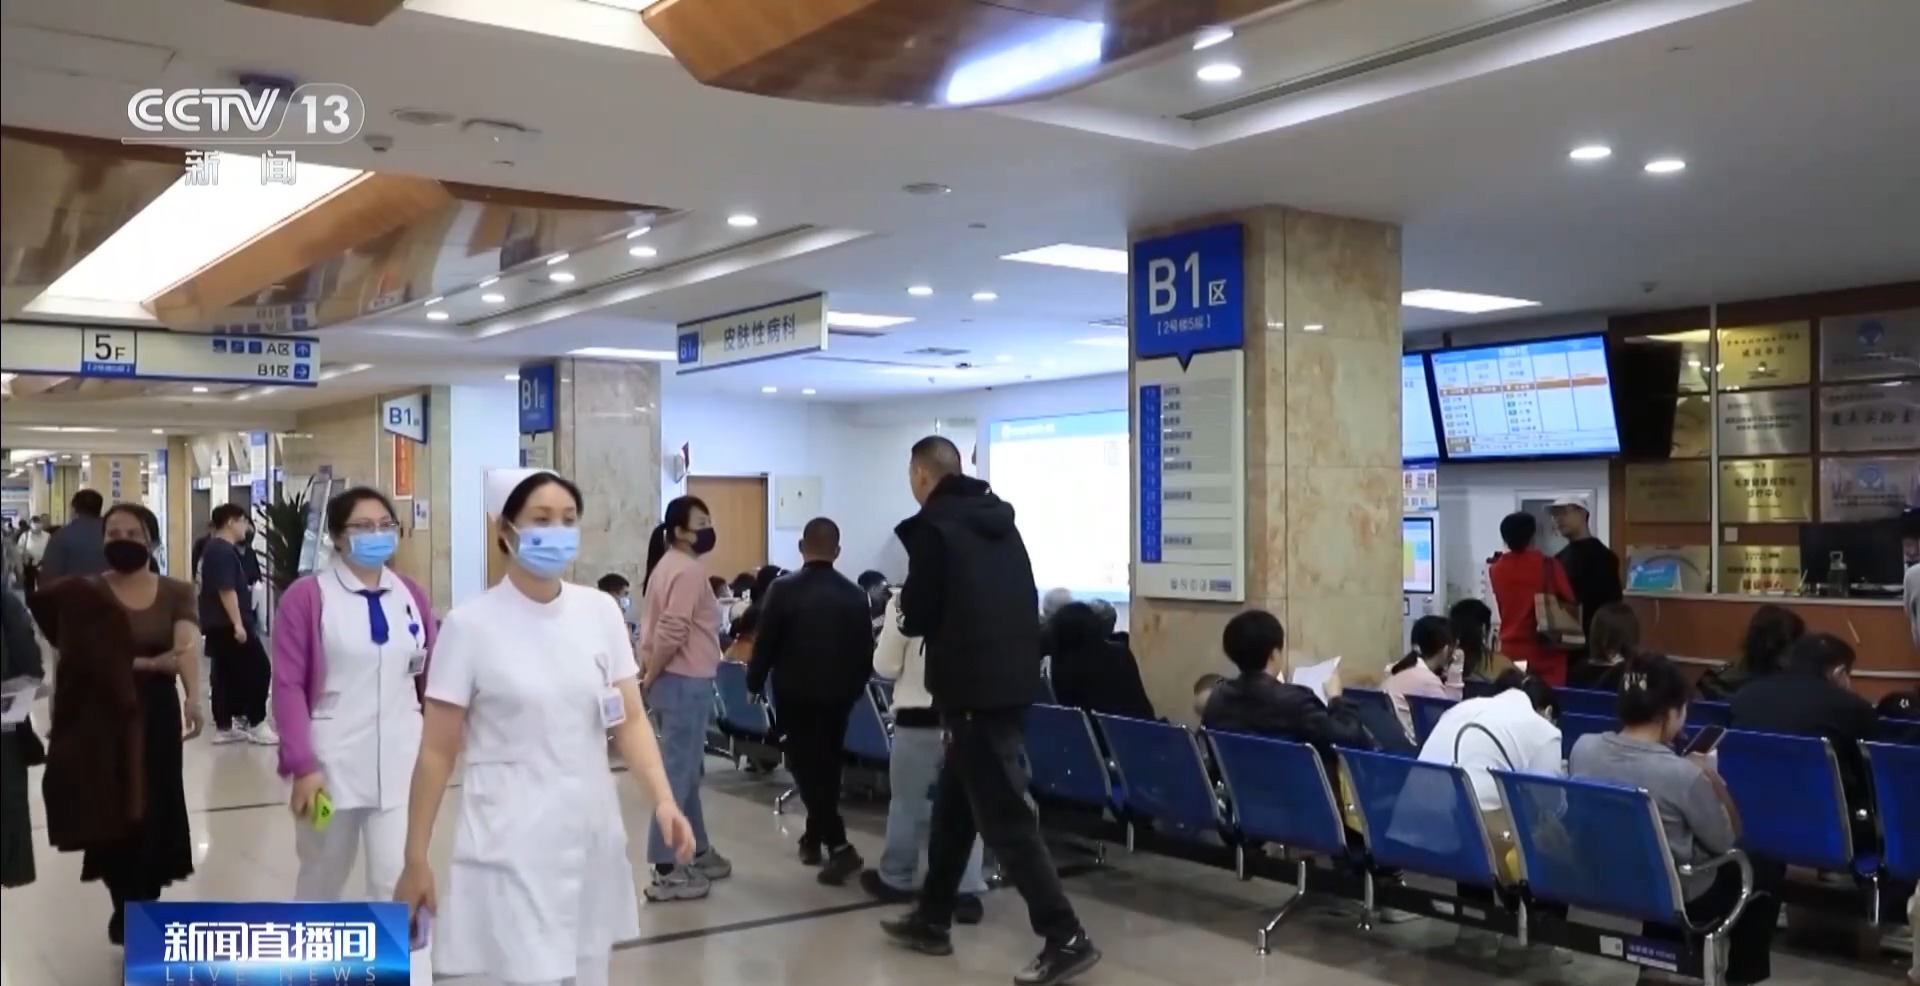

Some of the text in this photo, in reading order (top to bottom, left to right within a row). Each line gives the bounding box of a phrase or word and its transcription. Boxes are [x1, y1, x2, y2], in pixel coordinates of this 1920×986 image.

[1147, 251, 1228, 316] B1区
[723, 313, 796, 352] 皮肤性病科
[266, 342, 289, 356] A区
[257, 363, 289, 378] B1区
